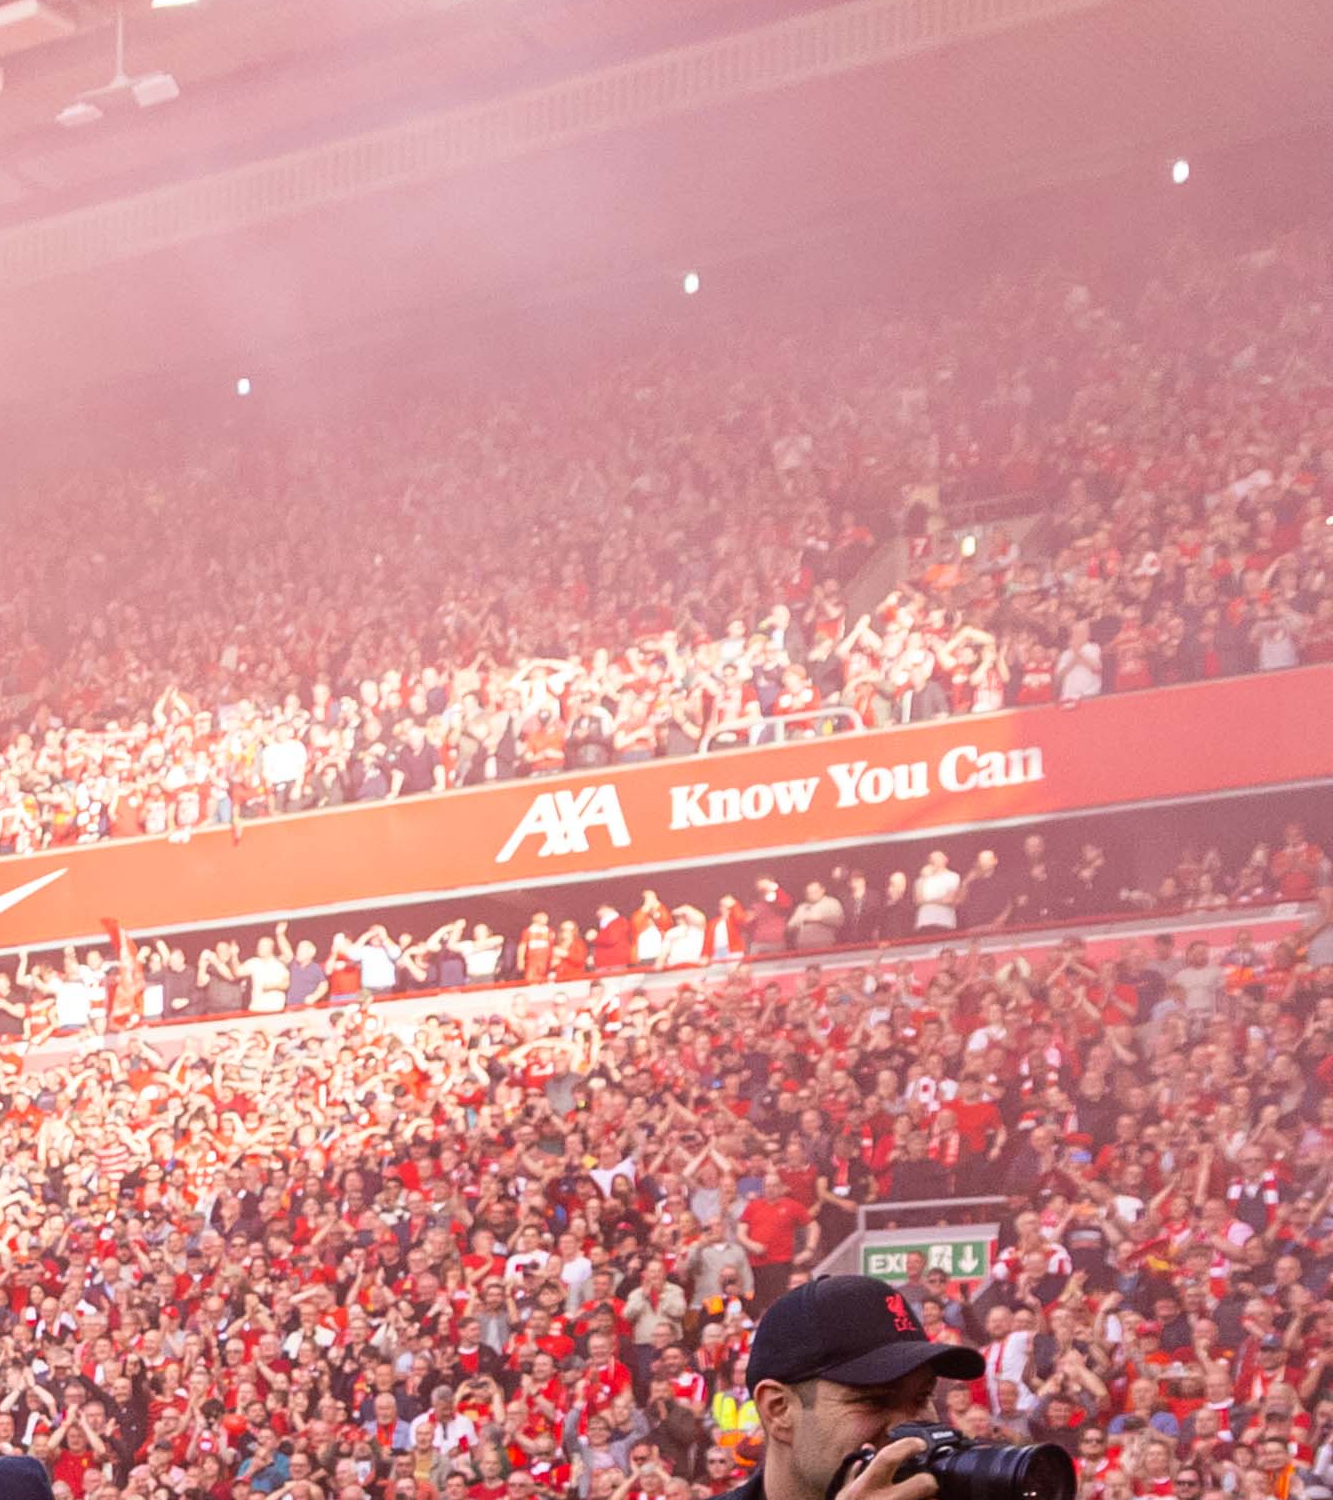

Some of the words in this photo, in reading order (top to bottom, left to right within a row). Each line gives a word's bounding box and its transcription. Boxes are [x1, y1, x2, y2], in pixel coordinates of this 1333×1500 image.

[495, 784, 631, 863] AXA
[668, 777, 819, 831] Know
[828, 759, 930, 808] You
[939, 743, 1046, 793] Can
